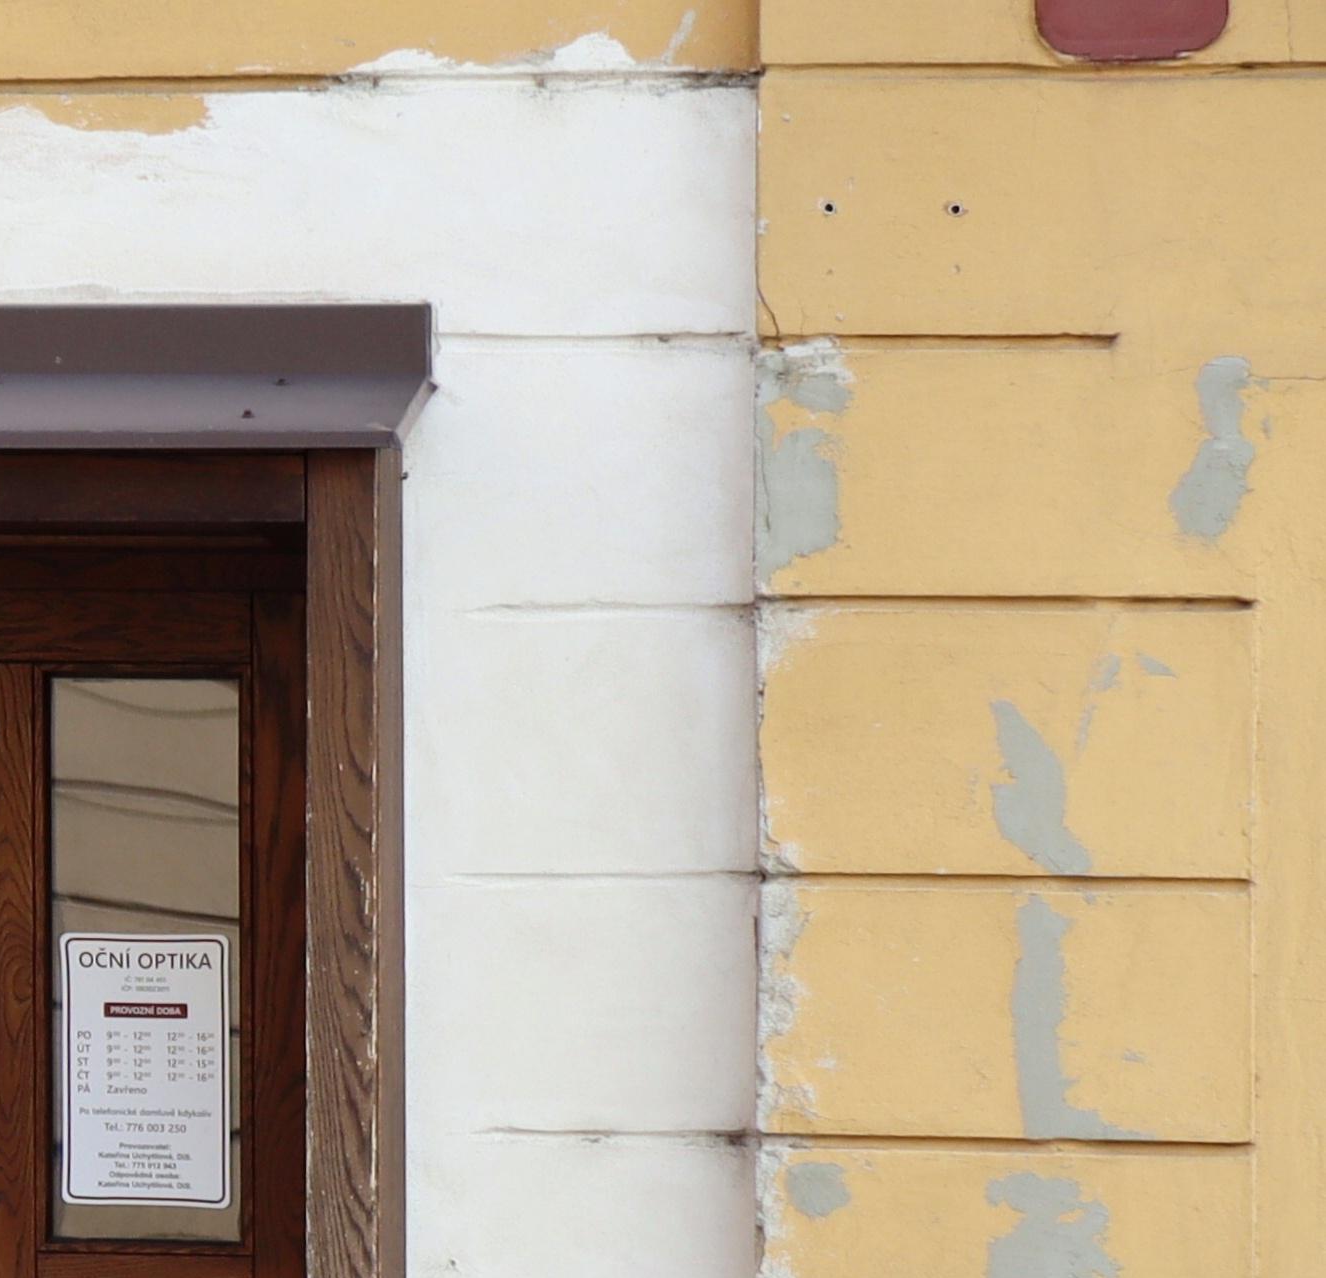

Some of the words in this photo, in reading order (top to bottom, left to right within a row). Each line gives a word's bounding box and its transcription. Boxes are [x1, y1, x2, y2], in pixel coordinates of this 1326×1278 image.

[79, 948, 130, 968] OČNÍ
[138, 952, 212, 970] OPTIKA
[109, 1005, 154, 1015] PROVOZNÍ
[156, 1006, 181, 1015] DOBA
[77, 1030, 92, 1040] PO
[77, 1042, 90, 1053] ÚT
[77, 1057, 89, 1067] ST
[77, 1069, 90, 1080] ČT
[77, 1083, 91, 1093] PÁ
[107, 1084, 147, 1095] Zavřeno
[126, 1123, 144, 1132] 776
[147, 1123, 165, 1133] 003
[168, 1124, 187, 1134] 250
